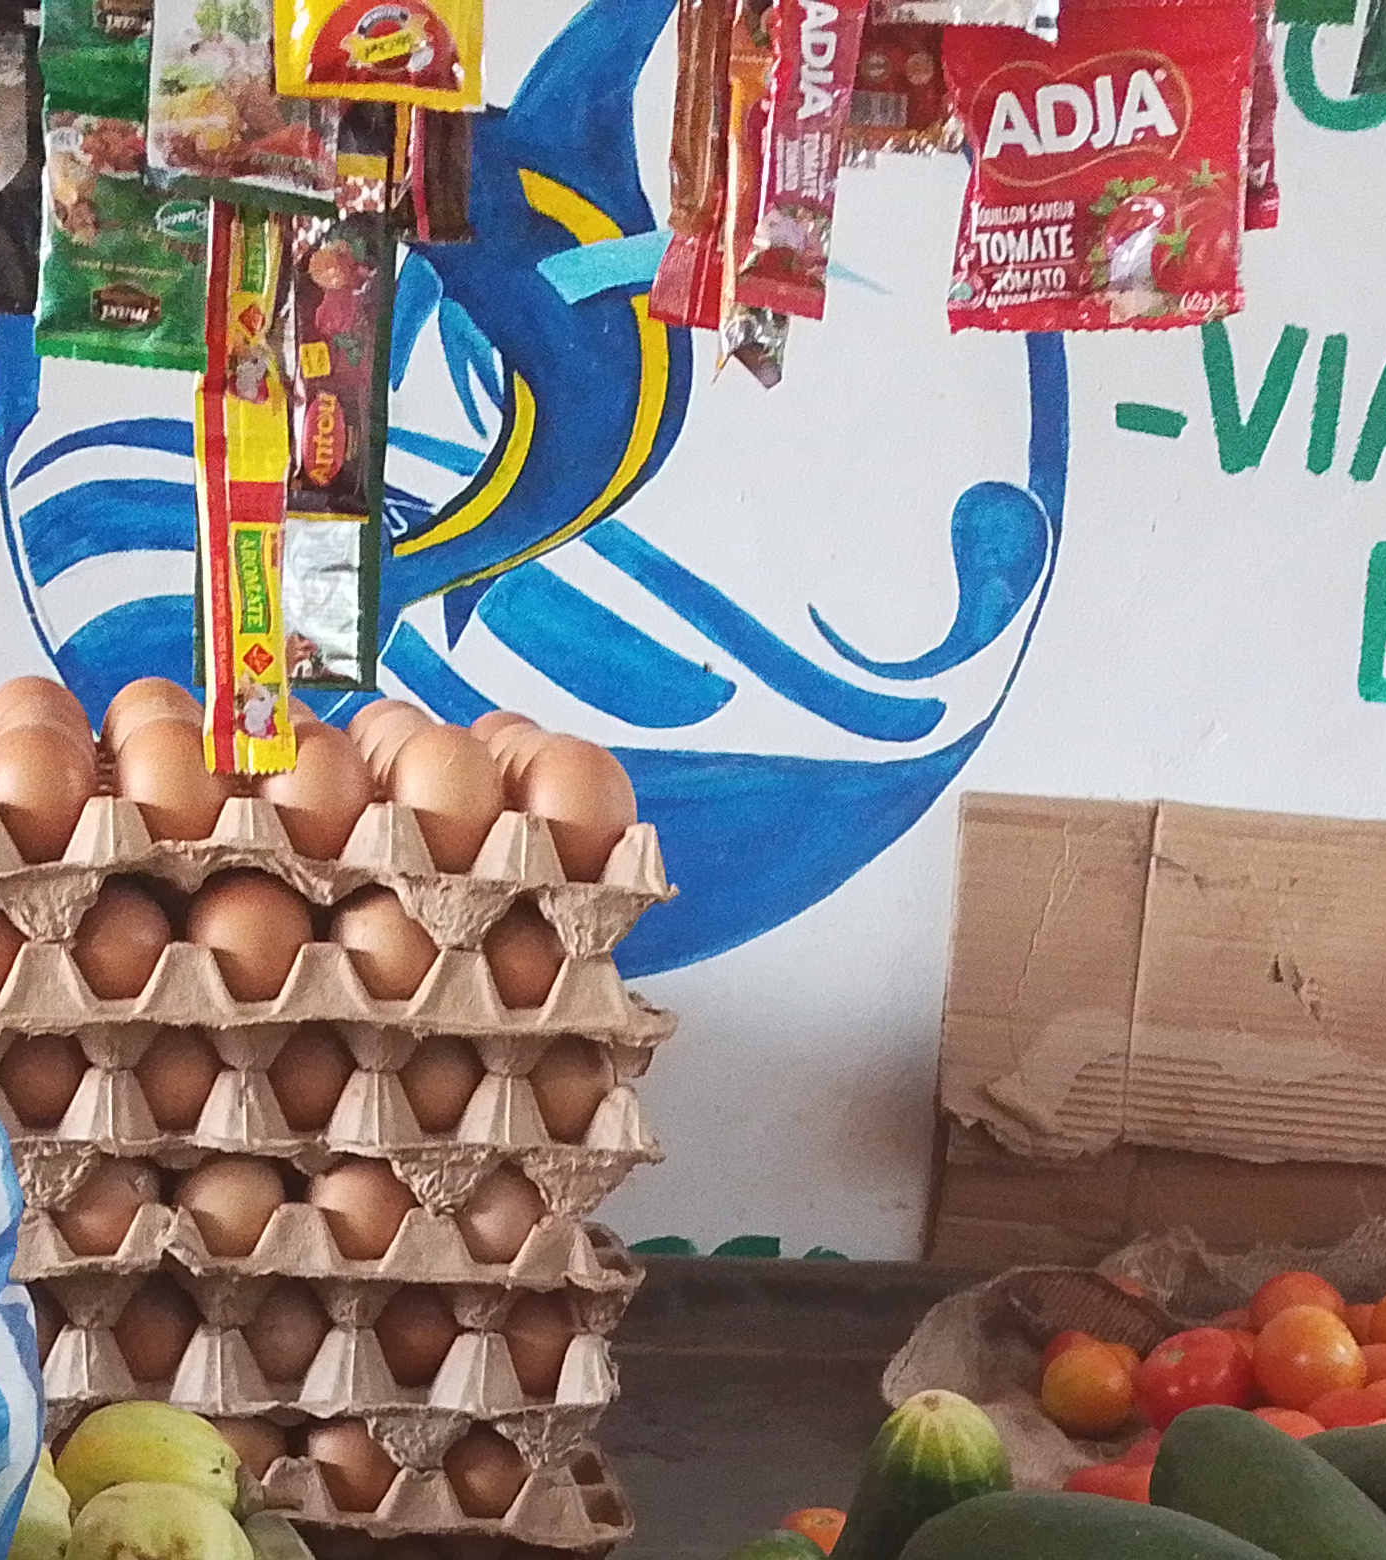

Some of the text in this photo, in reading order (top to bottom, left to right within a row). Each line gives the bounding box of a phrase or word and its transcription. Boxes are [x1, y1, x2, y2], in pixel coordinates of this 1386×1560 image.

[797, 0, 839, 120] ADJA
[982, 68, 1178, 160] ADJA
[976, 224, 1075, 268] TOMATE
